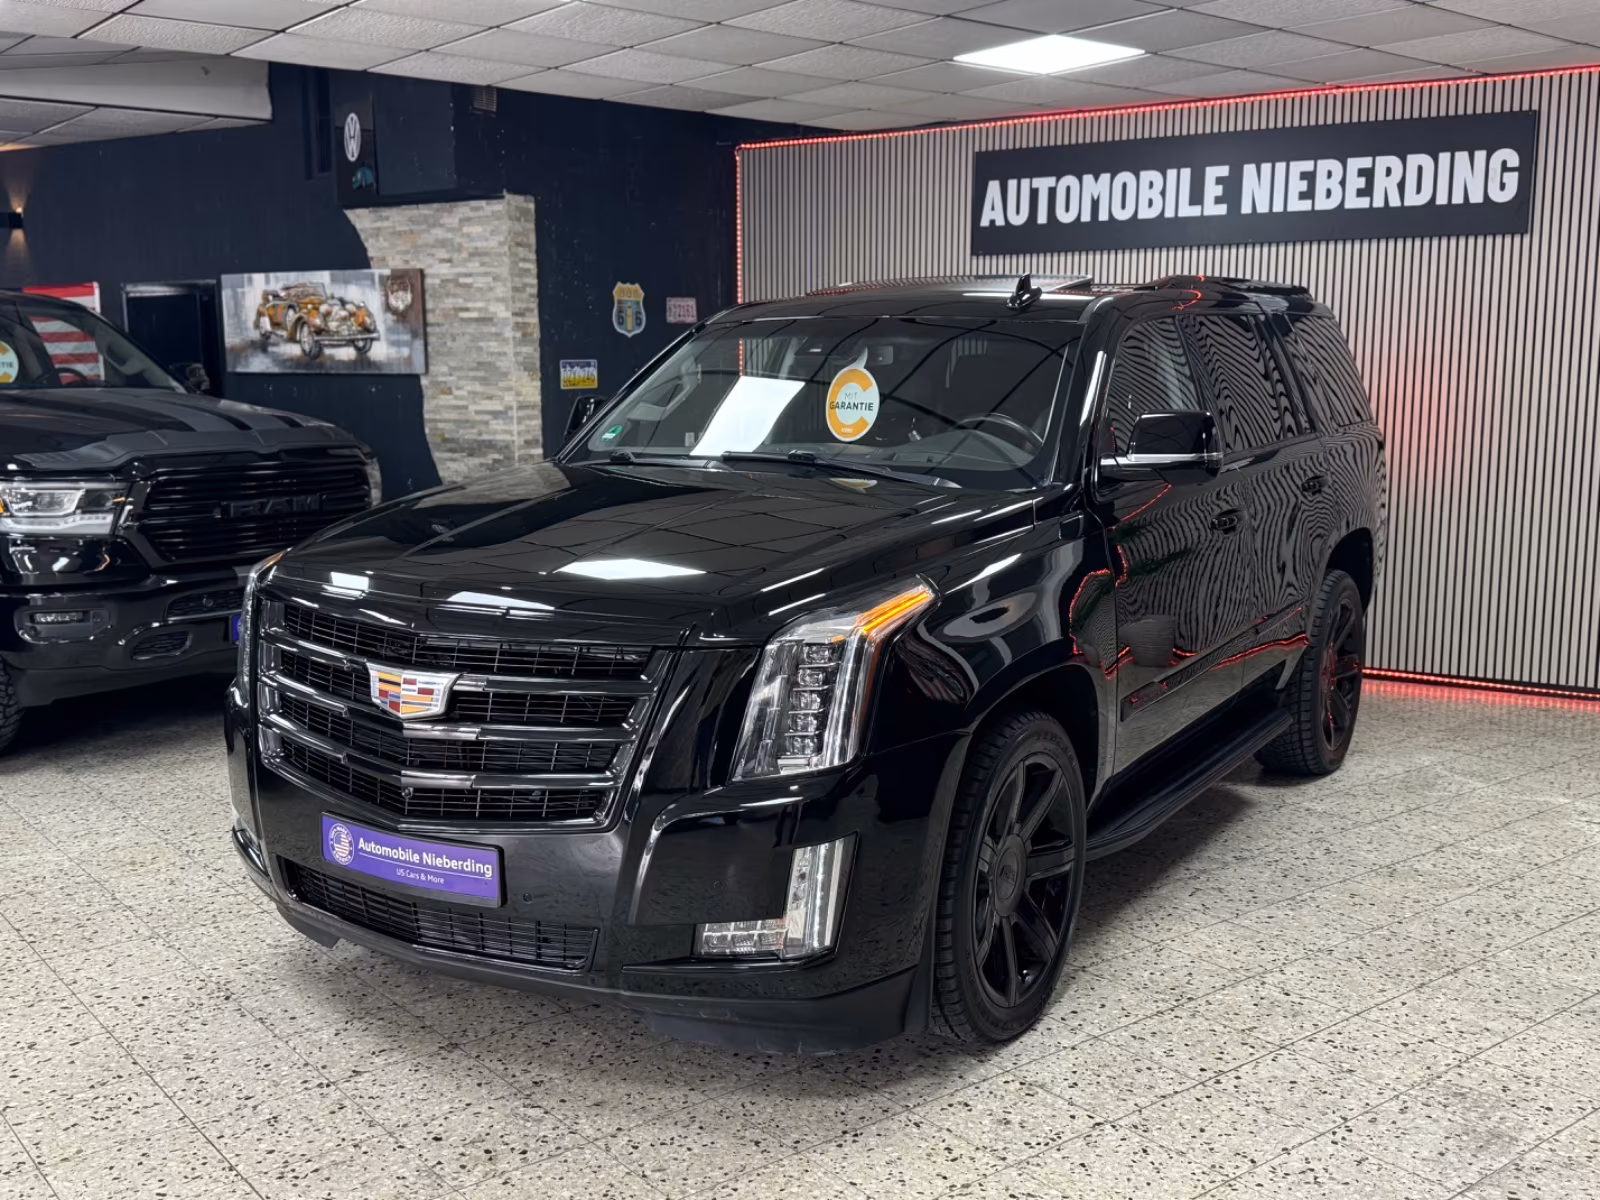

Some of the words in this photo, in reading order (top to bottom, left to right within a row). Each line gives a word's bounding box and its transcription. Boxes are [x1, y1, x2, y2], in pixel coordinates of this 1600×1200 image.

[980, 165, 1230, 227] AUTOMOBILE
[1240, 147, 1520, 215] NIEBERDING
[844, 392, 858, 400] MIT
[829, 401, 874, 412] GARANTIE
[230, 496, 320, 518] RAM
[358, 837, 420, 864] Automobile
[422, 852, 493, 877] Nieberding
[396, 868, 405, 877] US
[405, 869, 419, 880] Cars
[420, 872, 426, 881] &
[427, 874, 445, 885] More
